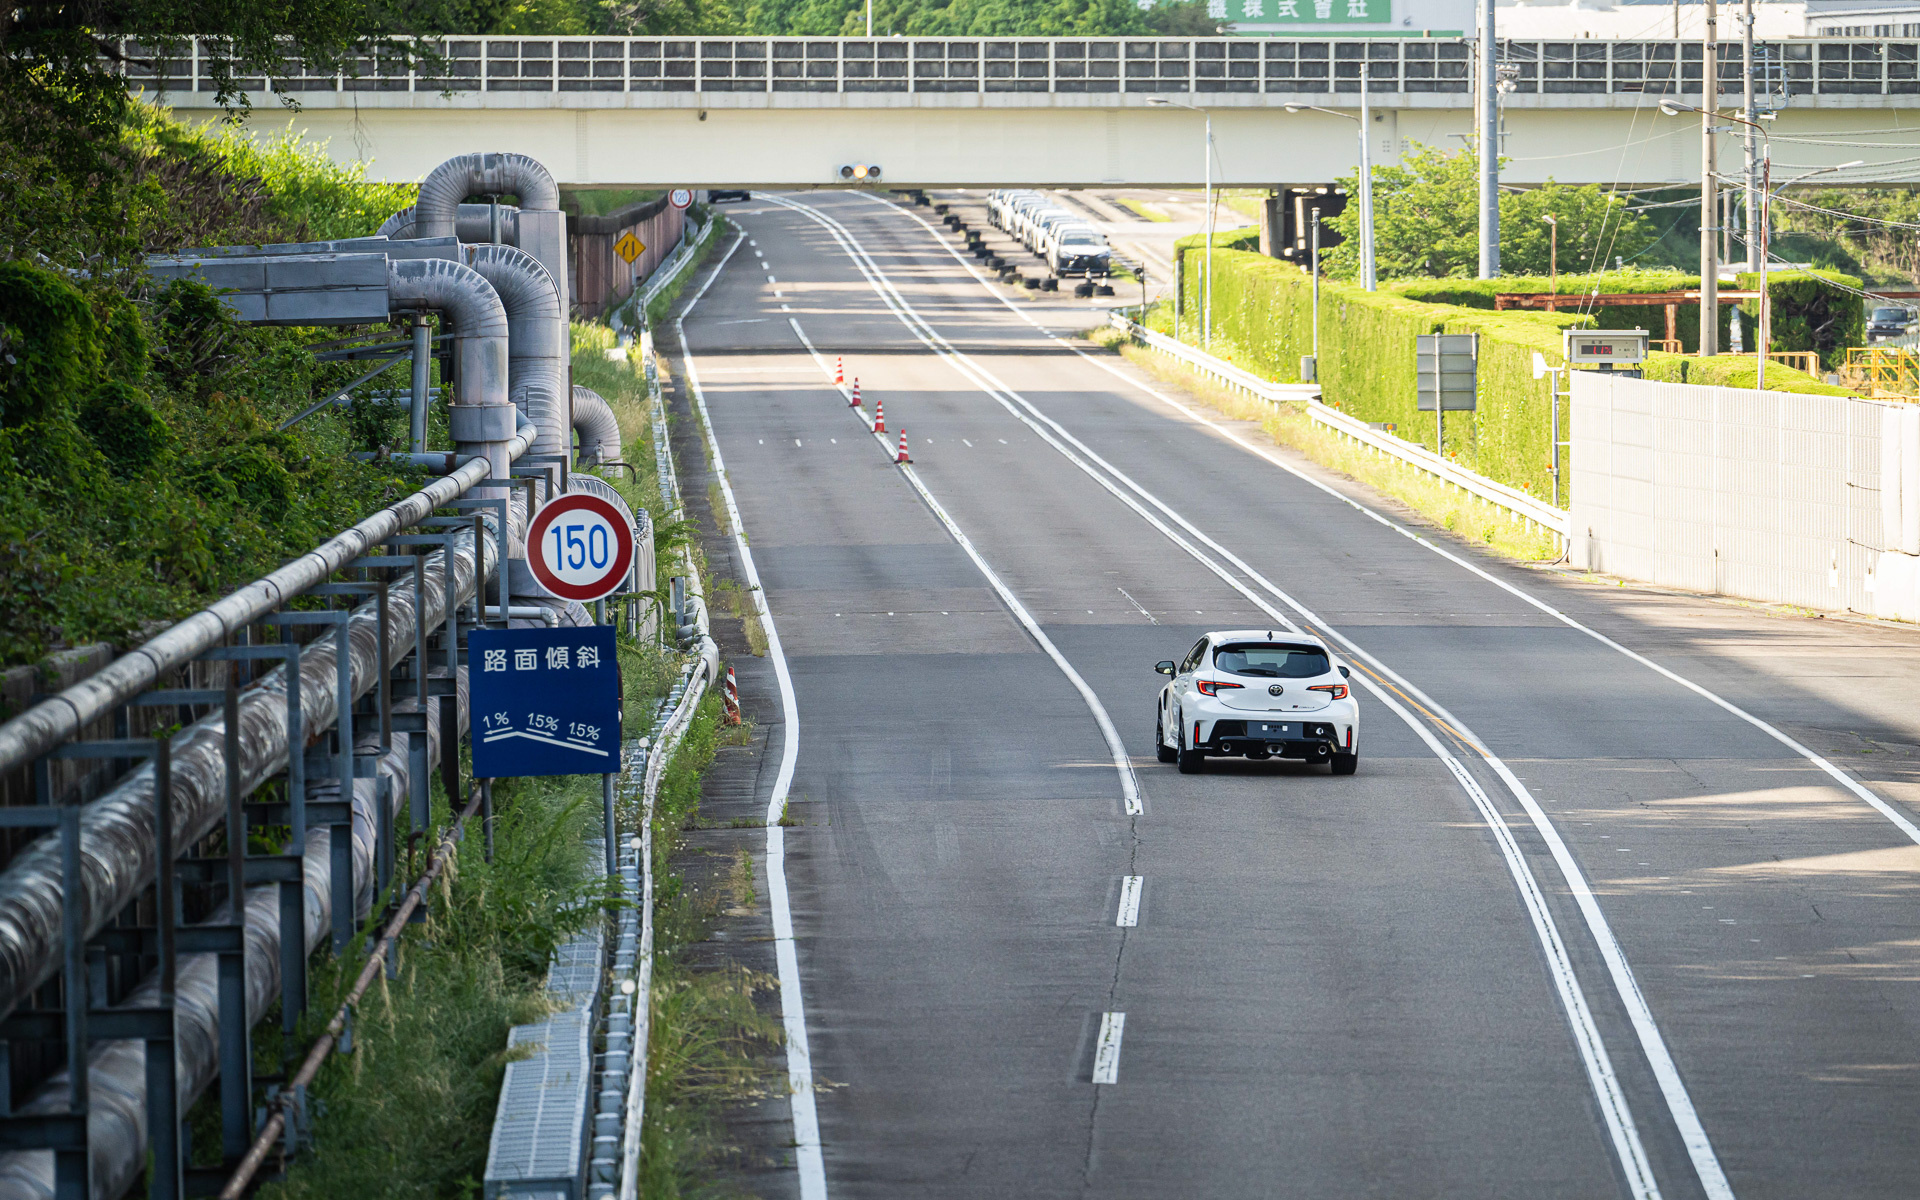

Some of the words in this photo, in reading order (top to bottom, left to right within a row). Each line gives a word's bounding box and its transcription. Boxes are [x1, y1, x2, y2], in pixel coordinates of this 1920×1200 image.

[674, 191, 688, 203] 120
[551, 524, 608, 571] 150
[484, 645, 601, 672] 路面傾斜
[527, 712, 560, 731] 1.5%
[568, 721, 601, 741] 1.5%
